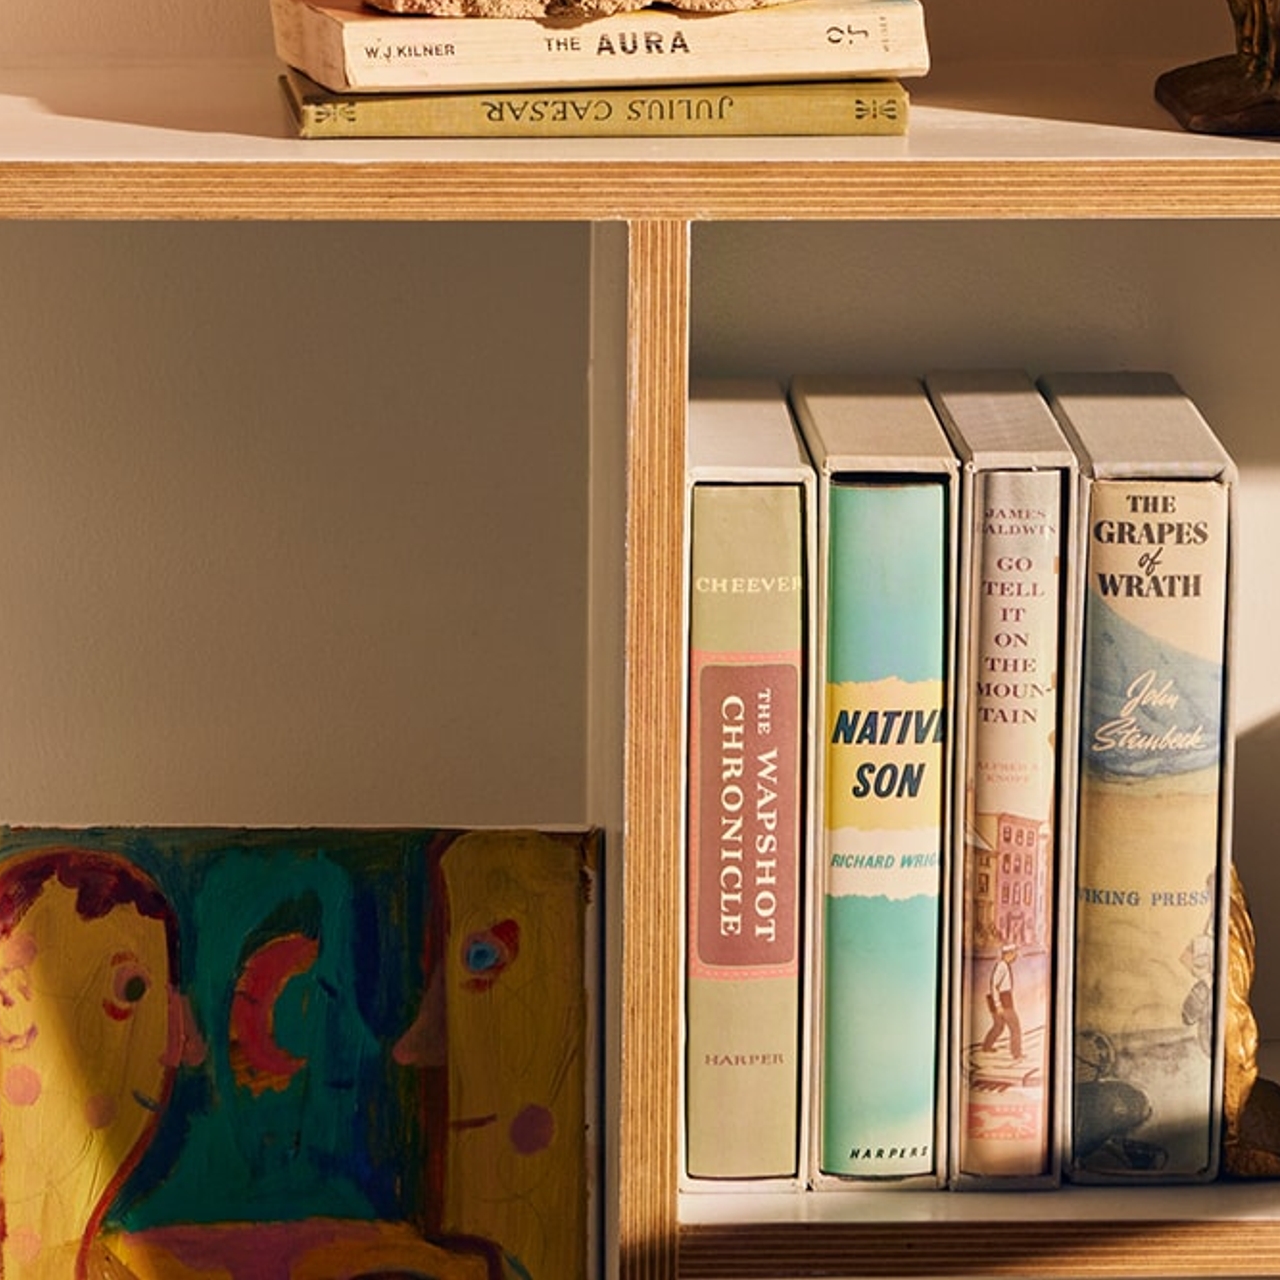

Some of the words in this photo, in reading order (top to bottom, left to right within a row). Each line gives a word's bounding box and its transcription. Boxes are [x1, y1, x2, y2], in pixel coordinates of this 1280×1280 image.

[545, 36, 582, 53] THE
[596, 31, 690, 57] AURA
[482, 100, 614, 123] CAESAR
[627, 95, 735, 122] JULIUS
[984, 508, 1047, 520] JAMES
[1125, 494, 1176, 514] THE
[1093, 520, 1209, 545] GRAPES
[996, 556, 1033, 572] GO
[1137, 547, 1164, 576] of
[694, 575, 802, 593] CHEEVER
[982, 582, 1045, 598] TELL
[1097, 573, 1202, 598] WRATH
[1000, 607, 1026, 623] IT
[994, 632, 1029, 648] ON
[984, 657, 1037, 673] THE
[1119, 669, 1180, 716] John
[756, 688, 772, 735] THE
[978, 708, 1038, 724] TAIN
[1091, 716, 1208, 753] Steinbeck
[851, 762, 925, 799] SON
[720, 695, 746, 937] CHRONICLE
[754, 749, 778, 943] WAPSHOT
[830, 852, 894, 869] RICHARD
[900, 852, 940, 869] WRIG
[1151, 890, 1210, 907] PRESS
[704, 1053, 784, 1067] HARPER
[848, 1147, 929, 1160] HARPERS
